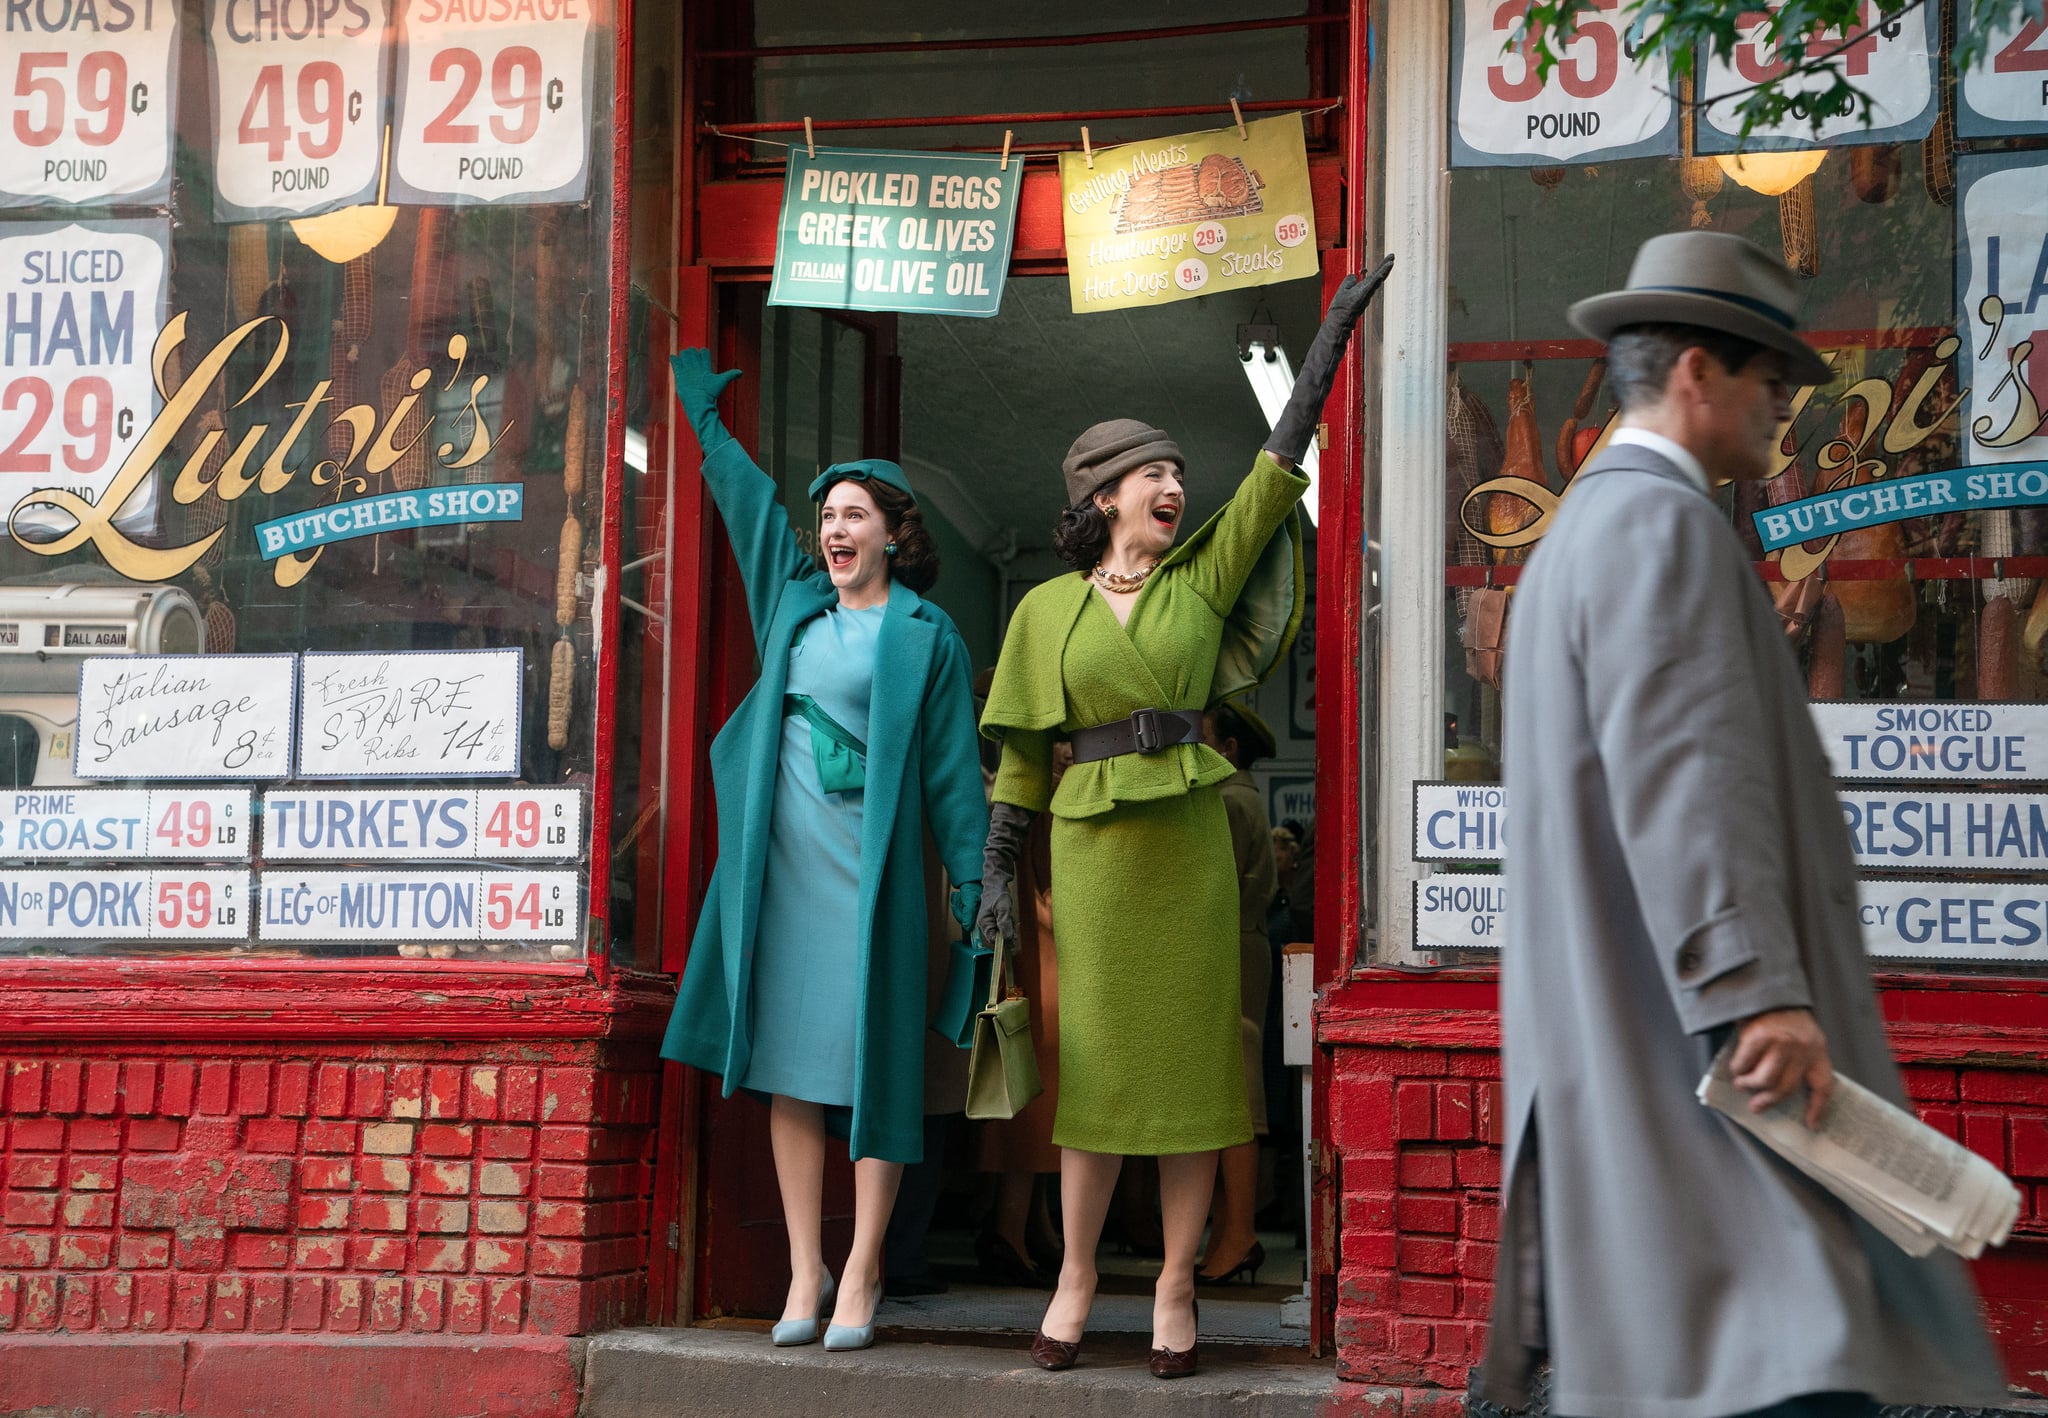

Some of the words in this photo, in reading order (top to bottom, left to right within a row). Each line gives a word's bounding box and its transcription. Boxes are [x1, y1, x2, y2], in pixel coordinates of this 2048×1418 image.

[225, 0, 371, 44] CHOPS
[1527, 112, 1600, 139] POUND
[44, 160, 107, 182] POUND
[272, 166, 329, 192] POUND
[459, 157, 523, 180] POUND
[1068, 167, 1131, 214] Grilling
[1132, 144, 1188, 181] Meats
[801, 169, 920, 208] PICKLED
[928, 175, 1002, 210] EGGS
[798, 211, 890, 249] GREEK
[898, 217, 996, 252] OLIVES
[1088, 232, 1188, 267] Hamburger
[1196, 229, 1216, 247] 29
[1278, 223, 1299, 241] 59
[21, 250, 124, 285] SLICED
[790, 261, 846, 280] ITALIAN
[854, 258, 937, 295] OLIVE
[946, 262, 990, 296] OIL
[1221, 244, 1284, 277] Steaks
[1082, 275, 1118, 303] Hot
[1123, 270, 1169, 298] Dogs
[1183, 268, 1192, 283] 9
[4, 290, 135, 366] HAM
[7, 309, 515, 588] Lutzi's
[263, 495, 421, 552] BUTCHER
[429, 489, 519, 517] SHOP
[1762, 478, 1956, 542] BUTCHER
[1966, 470, 2048, 500] SHO
[65, 633, 91, 645] CALL
[95, 633, 126, 645] AGAIN
[97, 664, 211, 727] Italian
[311, 660, 390, 702] Fresh
[94, 696, 257, 762] Sausage
[1875, 708, 1992, 732] SMOKED
[363, 734, 420, 766] Ribs
[1843, 735, 2026, 772] TONGUE
[15, 795, 75, 815] PRIME
[270, 798, 469, 848] TURKEYS
[485, 800, 541, 848] 49
[18, 817, 141, 850] ROAST
[157, 801, 212, 848] 49
[218, 826, 236, 844] LB
[547, 826, 566, 844] LB
[1839, 801, 1951, 857] RESH
[21, 892, 43, 910] OR
[47, 881, 142, 927] PORK
[158, 881, 212, 928] 59
[218, 908, 236, 925] LB
[266, 887, 314, 926] LEG
[317, 896, 338, 914] OF
[340, 882, 473, 929] MUTTON
[487, 883, 543, 930] 54
[545, 909, 564, 926] LB
[1896, 898, 2048, 946] GEES
[1471, 915, 1495, 935] OF
